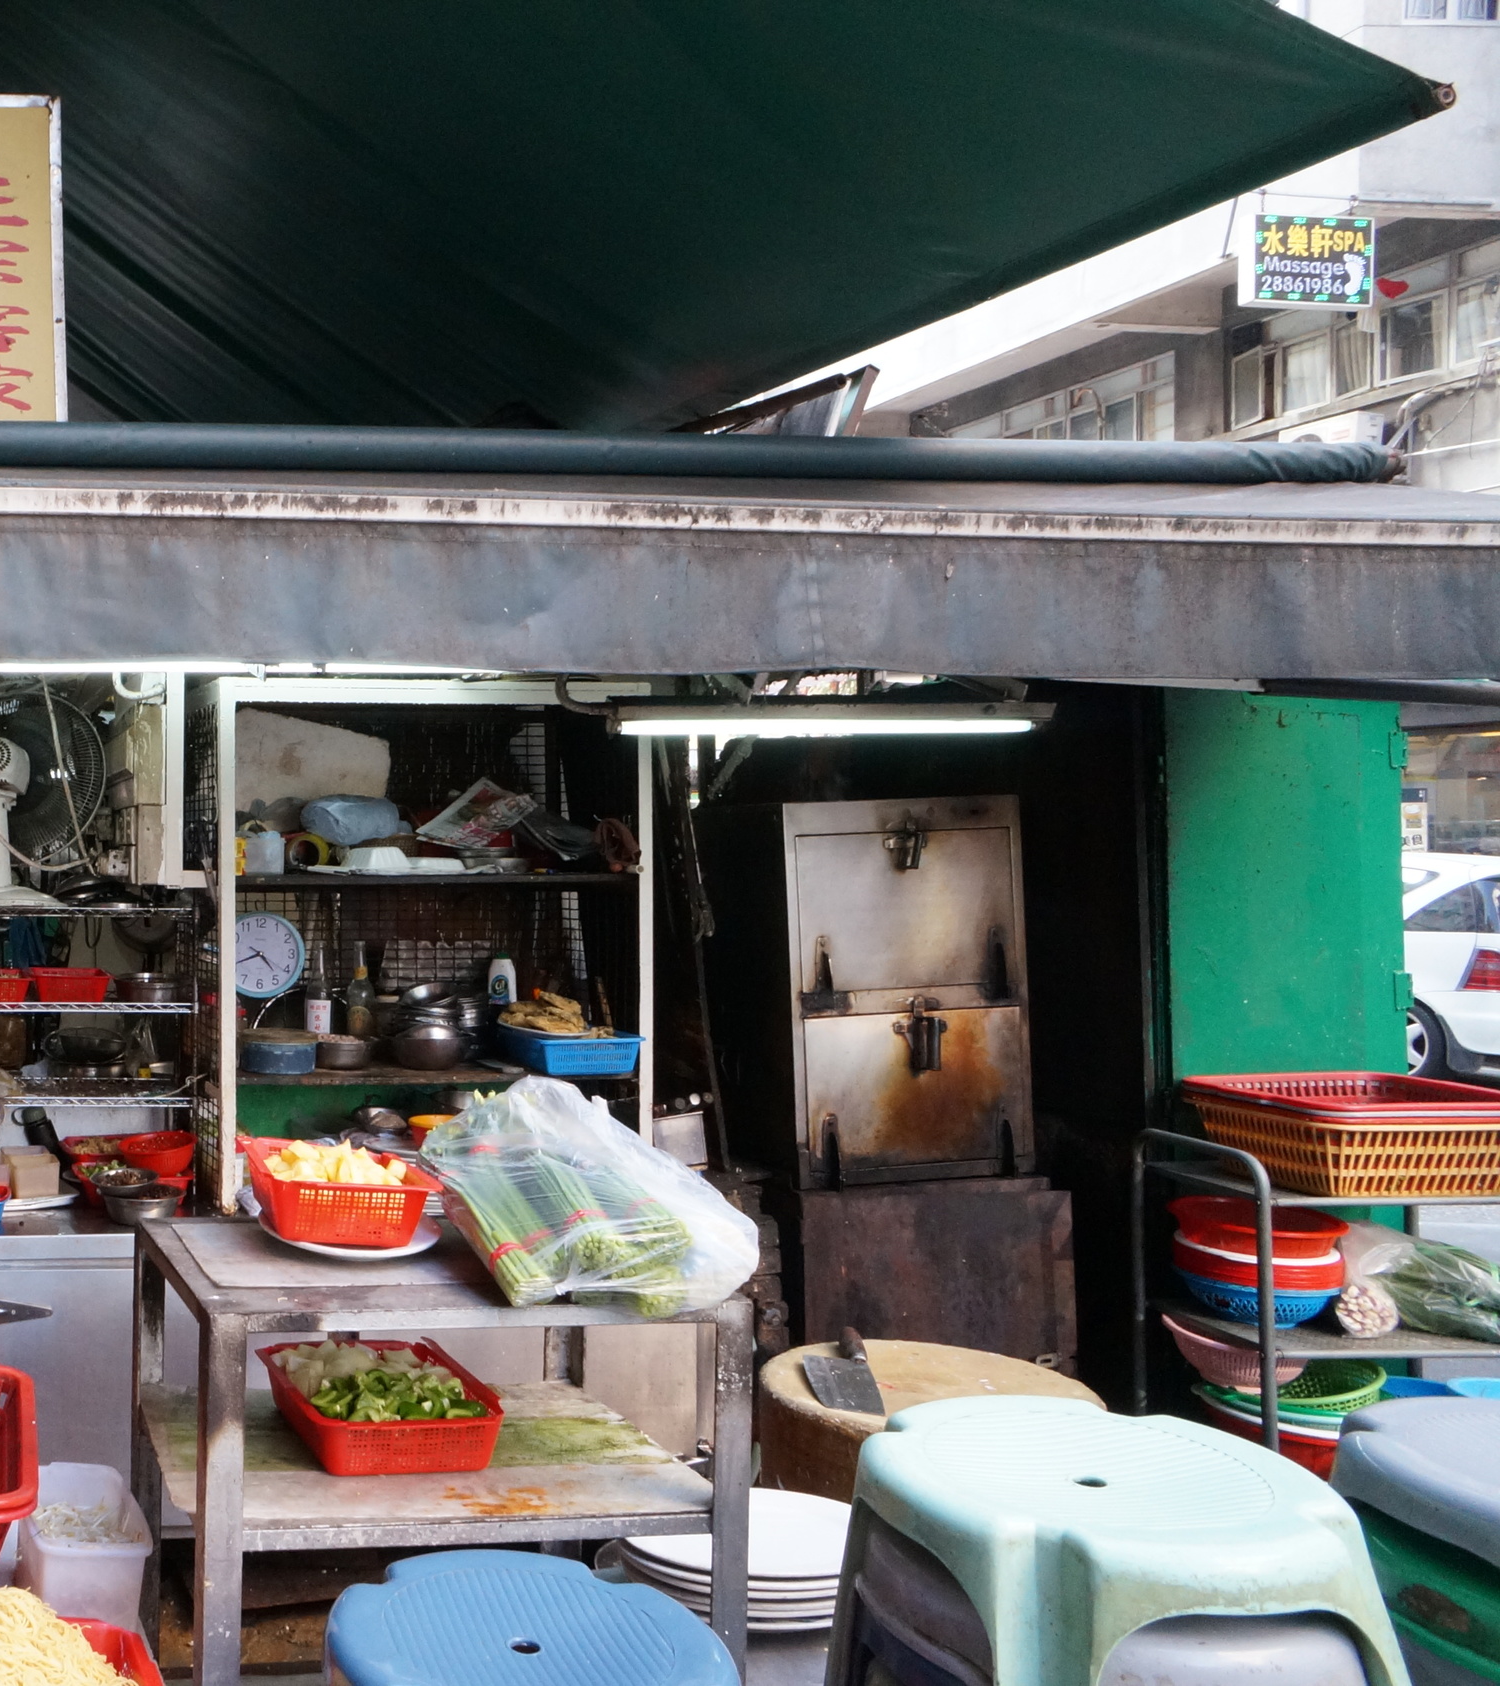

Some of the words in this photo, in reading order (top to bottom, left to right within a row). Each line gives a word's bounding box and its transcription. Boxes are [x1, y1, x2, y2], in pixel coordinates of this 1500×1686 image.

[1263, 256, 1345, 279] Massage
[1261, 275, 1343, 295] 28861986
[241, 922, 251, 932] 11
[256, 917, 267, 929] 12
[283, 933, 292, 944] 2
[287, 948, 296, 959] 3
[283, 964, 291, 974] 4
[241, 974, 249, 985] 7
[255, 979, 264, 990] 6
[271, 975, 280, 986] 5
